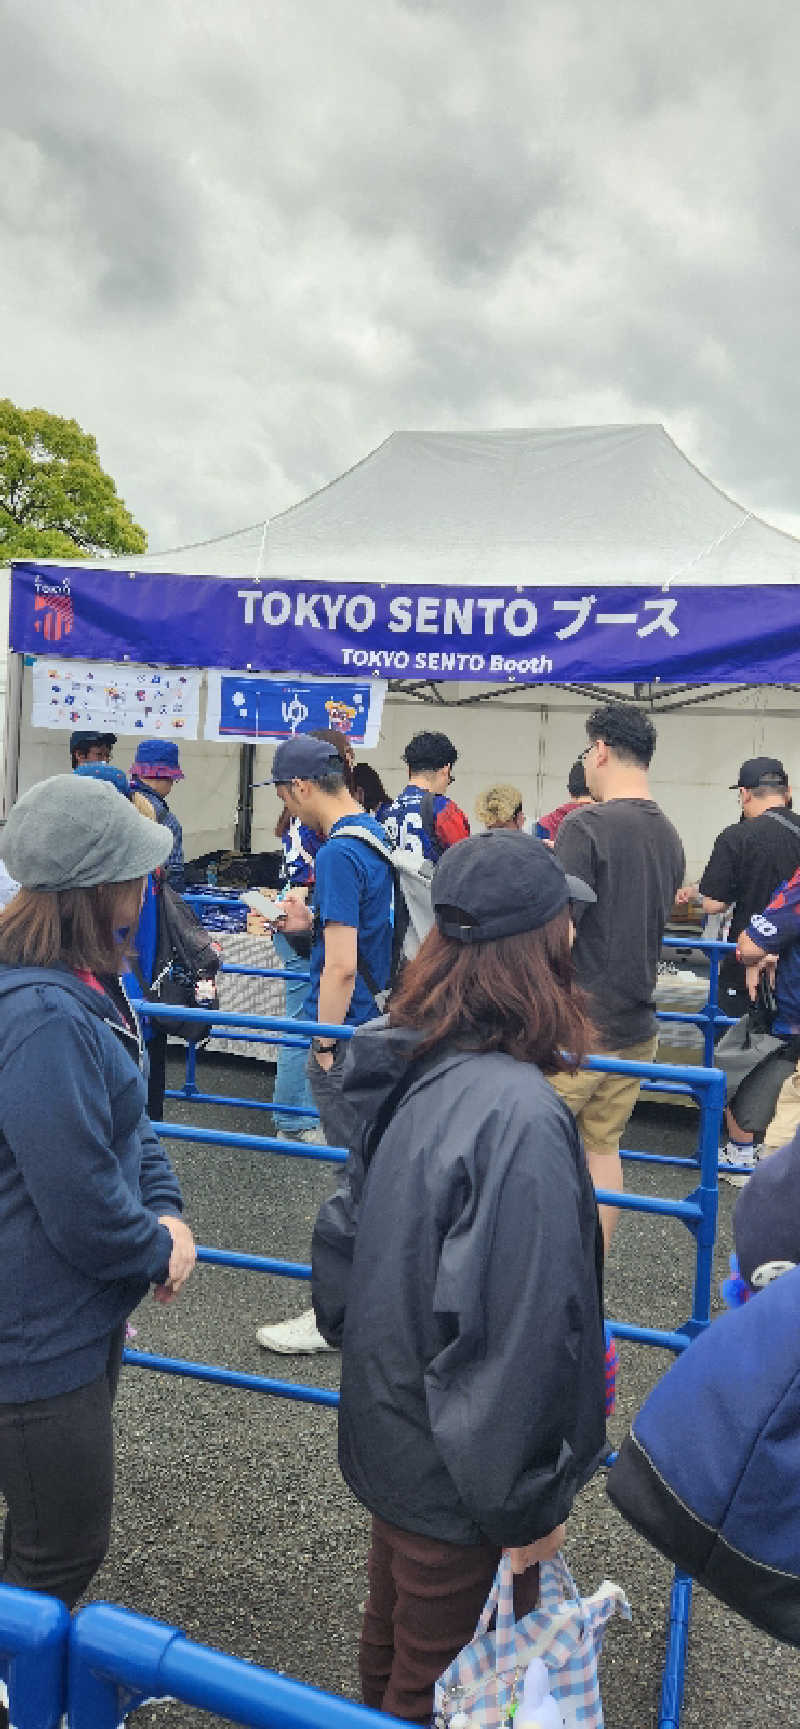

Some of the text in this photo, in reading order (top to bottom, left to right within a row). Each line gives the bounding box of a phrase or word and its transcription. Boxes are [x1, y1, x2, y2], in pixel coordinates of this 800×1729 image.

[238, 590, 680, 640] TOKYO SENTO ブース
[341, 648, 554, 674] TOKYO SENTO Booth
